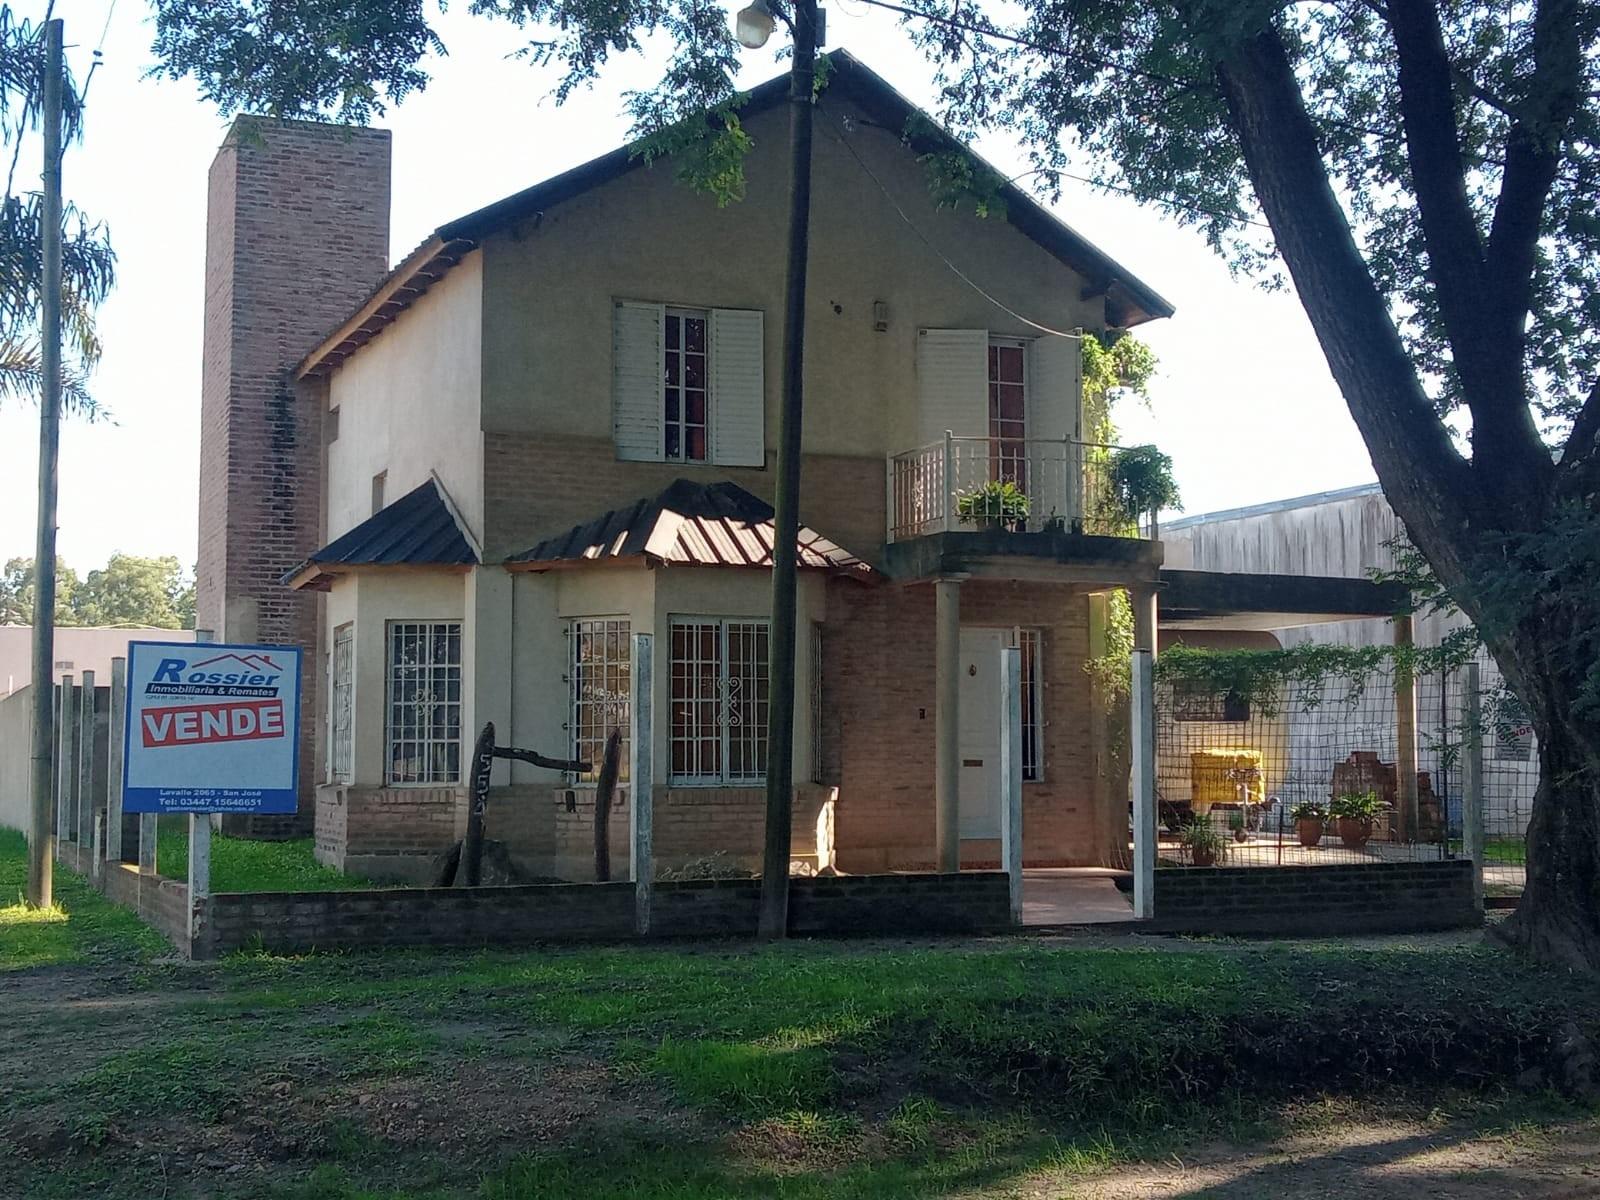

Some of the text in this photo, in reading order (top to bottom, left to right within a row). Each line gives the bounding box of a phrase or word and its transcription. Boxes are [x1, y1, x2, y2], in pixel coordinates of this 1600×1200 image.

[152, 658, 280, 686] Rossier
[149, 684, 275, 697] Inmobiliaria & Remates
[143, 705, 283, 742] VENDE
[223, 789, 239, 797] San
[159, 797, 178, 806] Tel:
[180, 798, 212, 806] 03447
